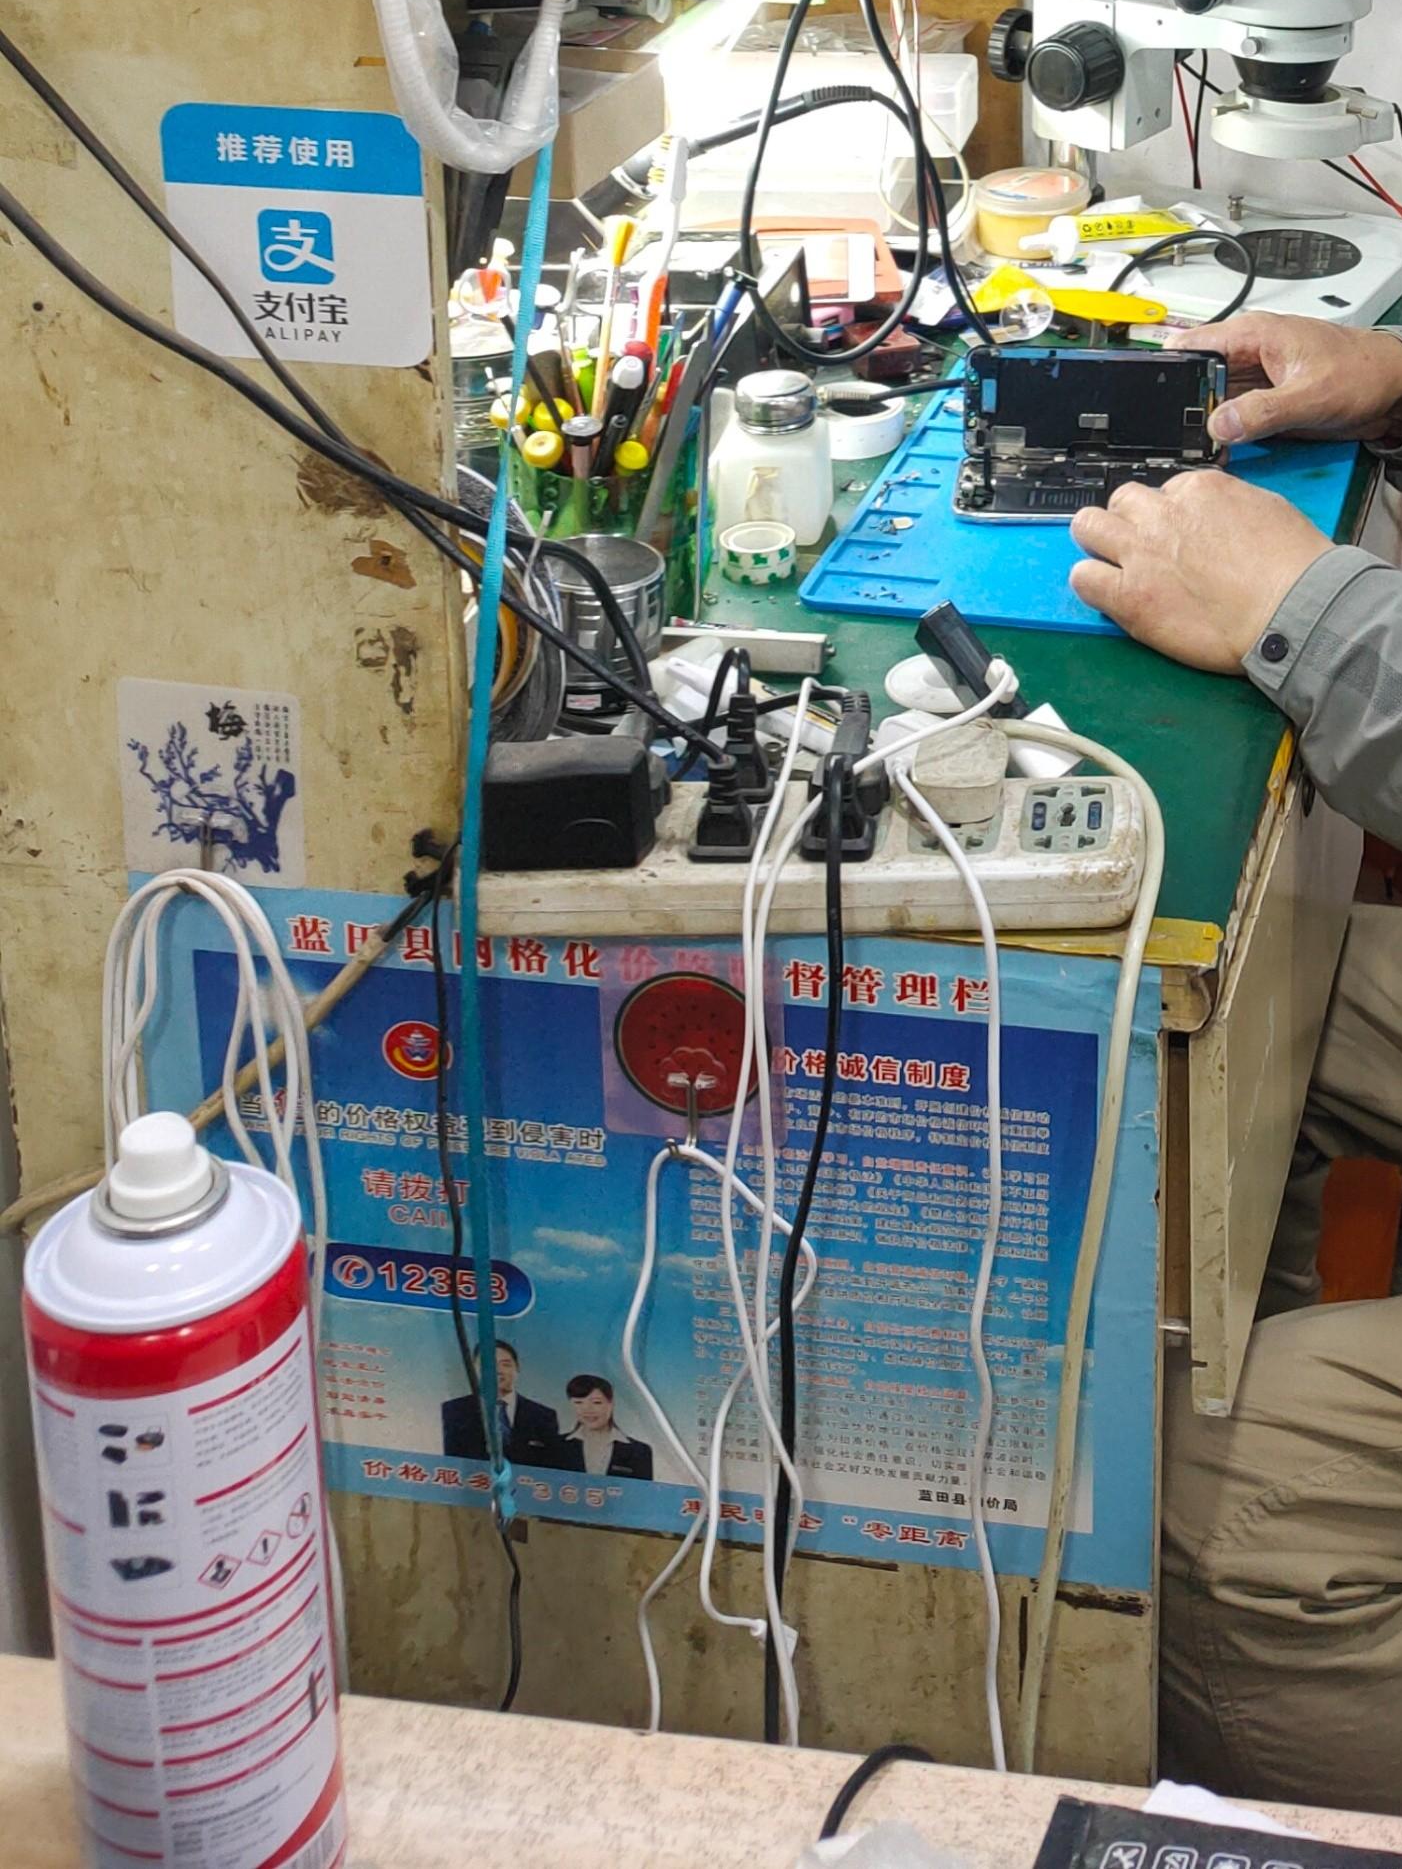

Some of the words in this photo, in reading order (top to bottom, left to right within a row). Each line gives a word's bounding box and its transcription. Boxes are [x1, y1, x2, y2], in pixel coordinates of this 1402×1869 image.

[216, 132, 354, 169] 推荐使用
[253, 290, 349, 326] 支付宝
[264, 326, 343, 343] ALIPAY
[917, 1488, 1019, 1513] 蓝田县价局
